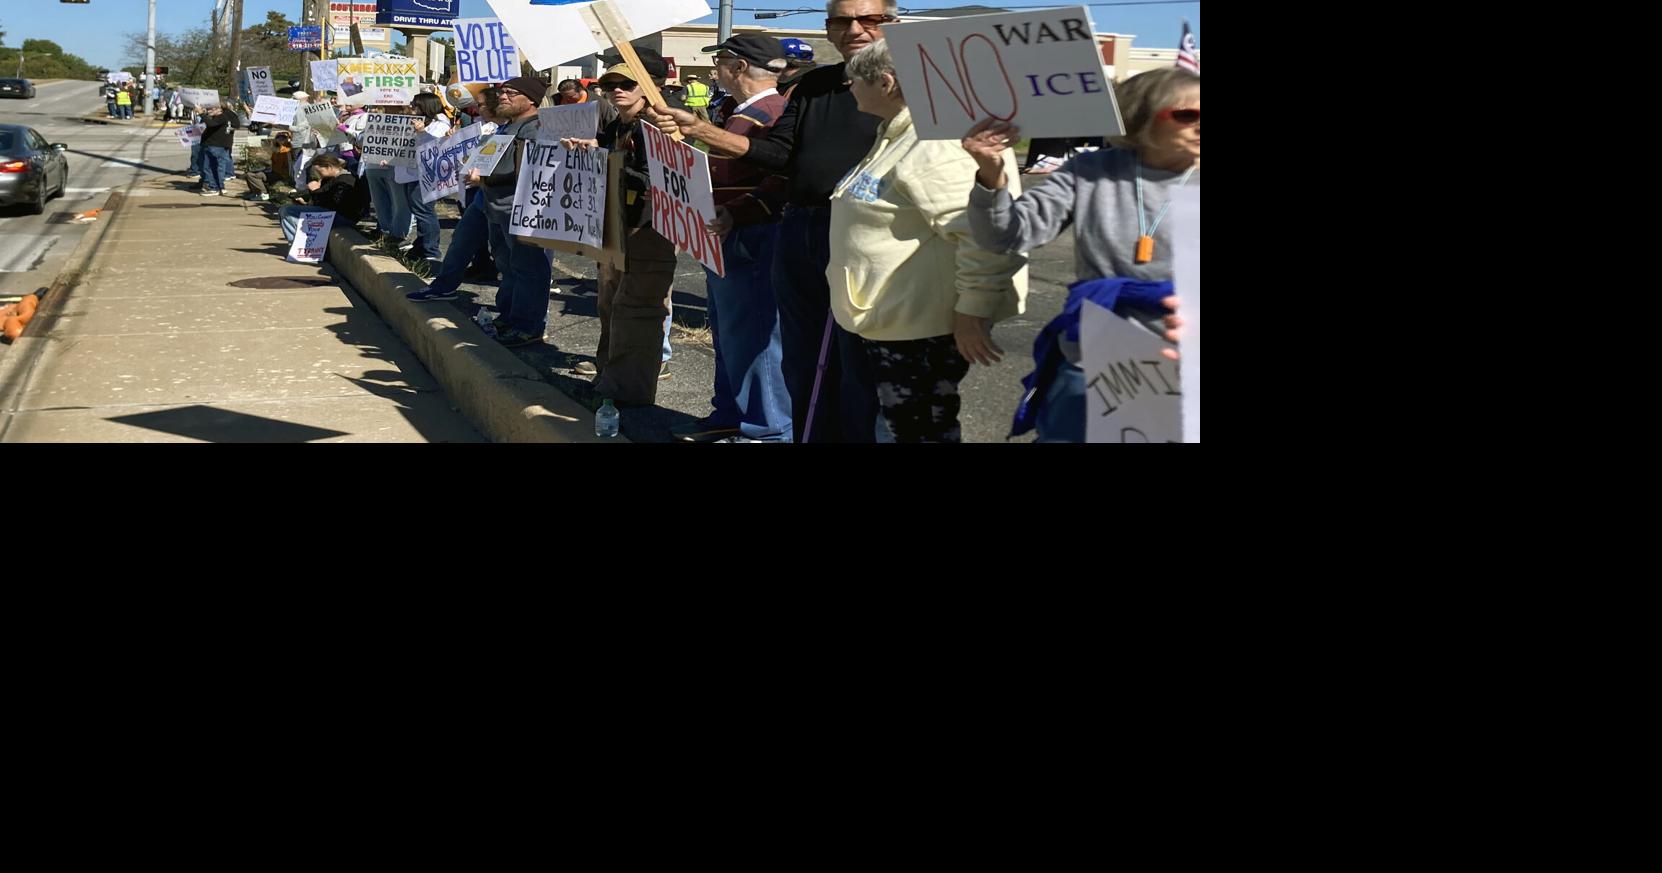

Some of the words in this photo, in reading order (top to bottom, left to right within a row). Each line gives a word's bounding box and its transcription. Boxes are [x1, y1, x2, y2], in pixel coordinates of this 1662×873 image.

[419, 17, 439, 25] THRU
[994, 18, 1093, 47] WAR
[454, 22, 514, 51] VOTE
[251, 70, 268, 80] NO
[457, 49, 515, 82] BLUE
[917, 32, 1019, 125] NO
[364, 76, 415, 87] FIRST
[1026, 71, 1104, 97] ICE
[367, 113, 382, 123] DO
[363, 145, 406, 158] DESERVE
[407, 149, 417, 159] IT
[367, 135, 389, 145] OUR
[391, 137, 416, 147] KIDS
[526, 141, 558, 168] VOTE
[644, 124, 695, 179] TRUMP
[531, 170, 556, 192] Wed
[563, 172, 582, 194] Oct
[662, 166, 690, 203] FOR
[530, 191, 553, 208] Sat
[560, 193, 583, 209] Oct
[511, 204, 558, 231] Election
[564, 212, 584, 241] Day
[650, 185, 726, 279] PRISON
[1087, 358, 1182, 417] IMMI
